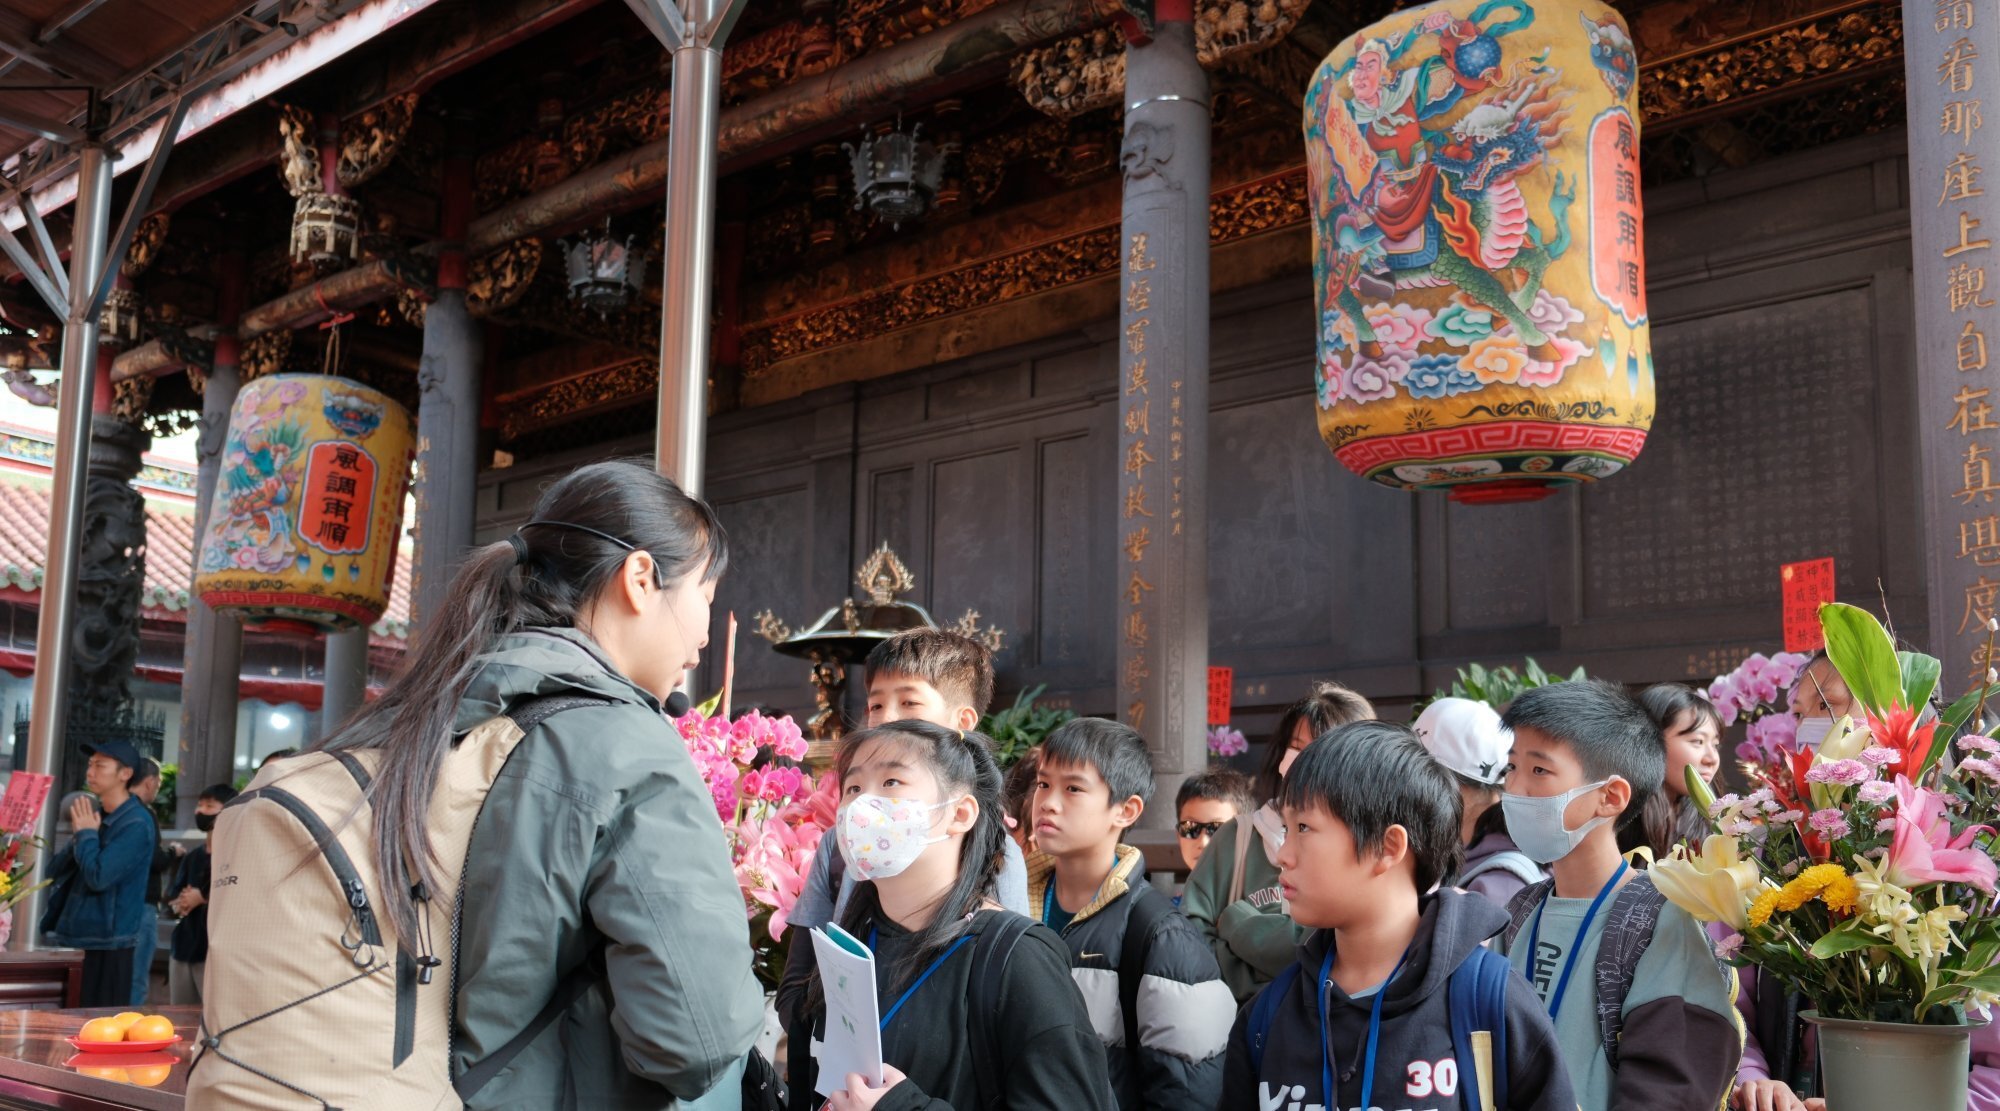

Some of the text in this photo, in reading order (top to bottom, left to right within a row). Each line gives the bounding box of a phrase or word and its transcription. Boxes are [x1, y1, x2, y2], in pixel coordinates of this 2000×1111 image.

[1614, 119, 1640, 299] 風調雨順
[315, 446, 362, 545] 風調雨順
[1248, 886, 1284, 908] YIN
[1406, 1058, 1459, 1098] 30
